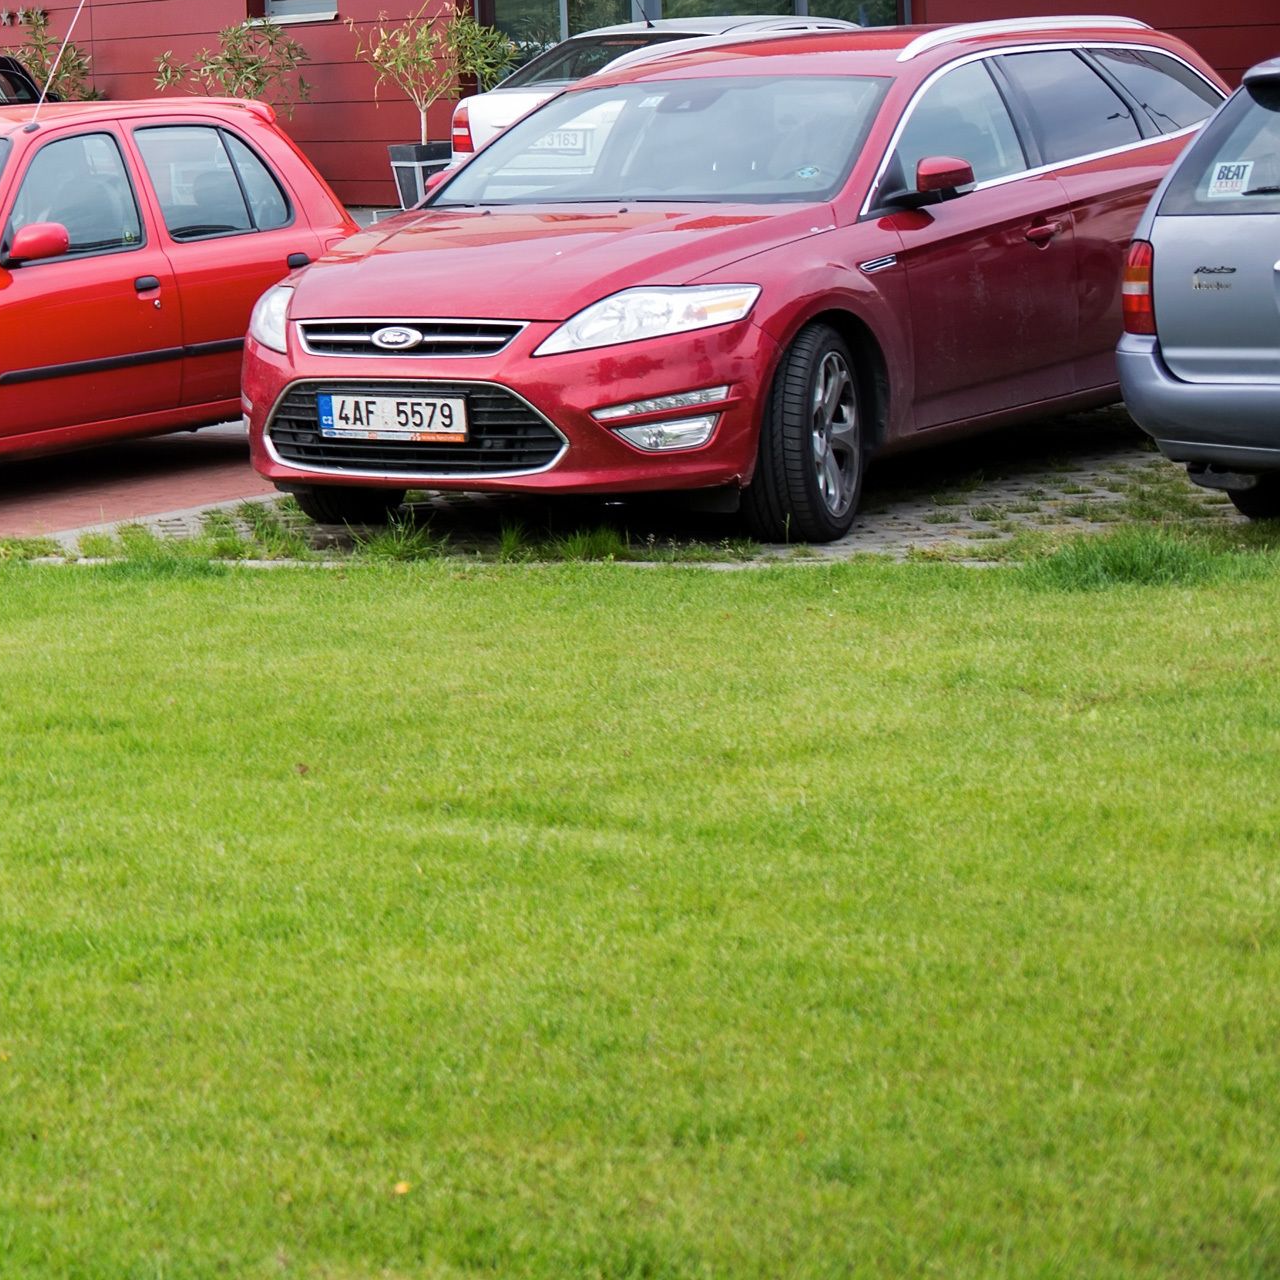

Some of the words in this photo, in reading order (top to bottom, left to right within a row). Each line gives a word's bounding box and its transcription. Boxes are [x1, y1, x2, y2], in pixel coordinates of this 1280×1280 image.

[547, 133, 578, 146] 3163
[1217, 164, 1250, 181] BEAT
[338, 399, 377, 426] 4AF
[396, 401, 454, 428] 5579
